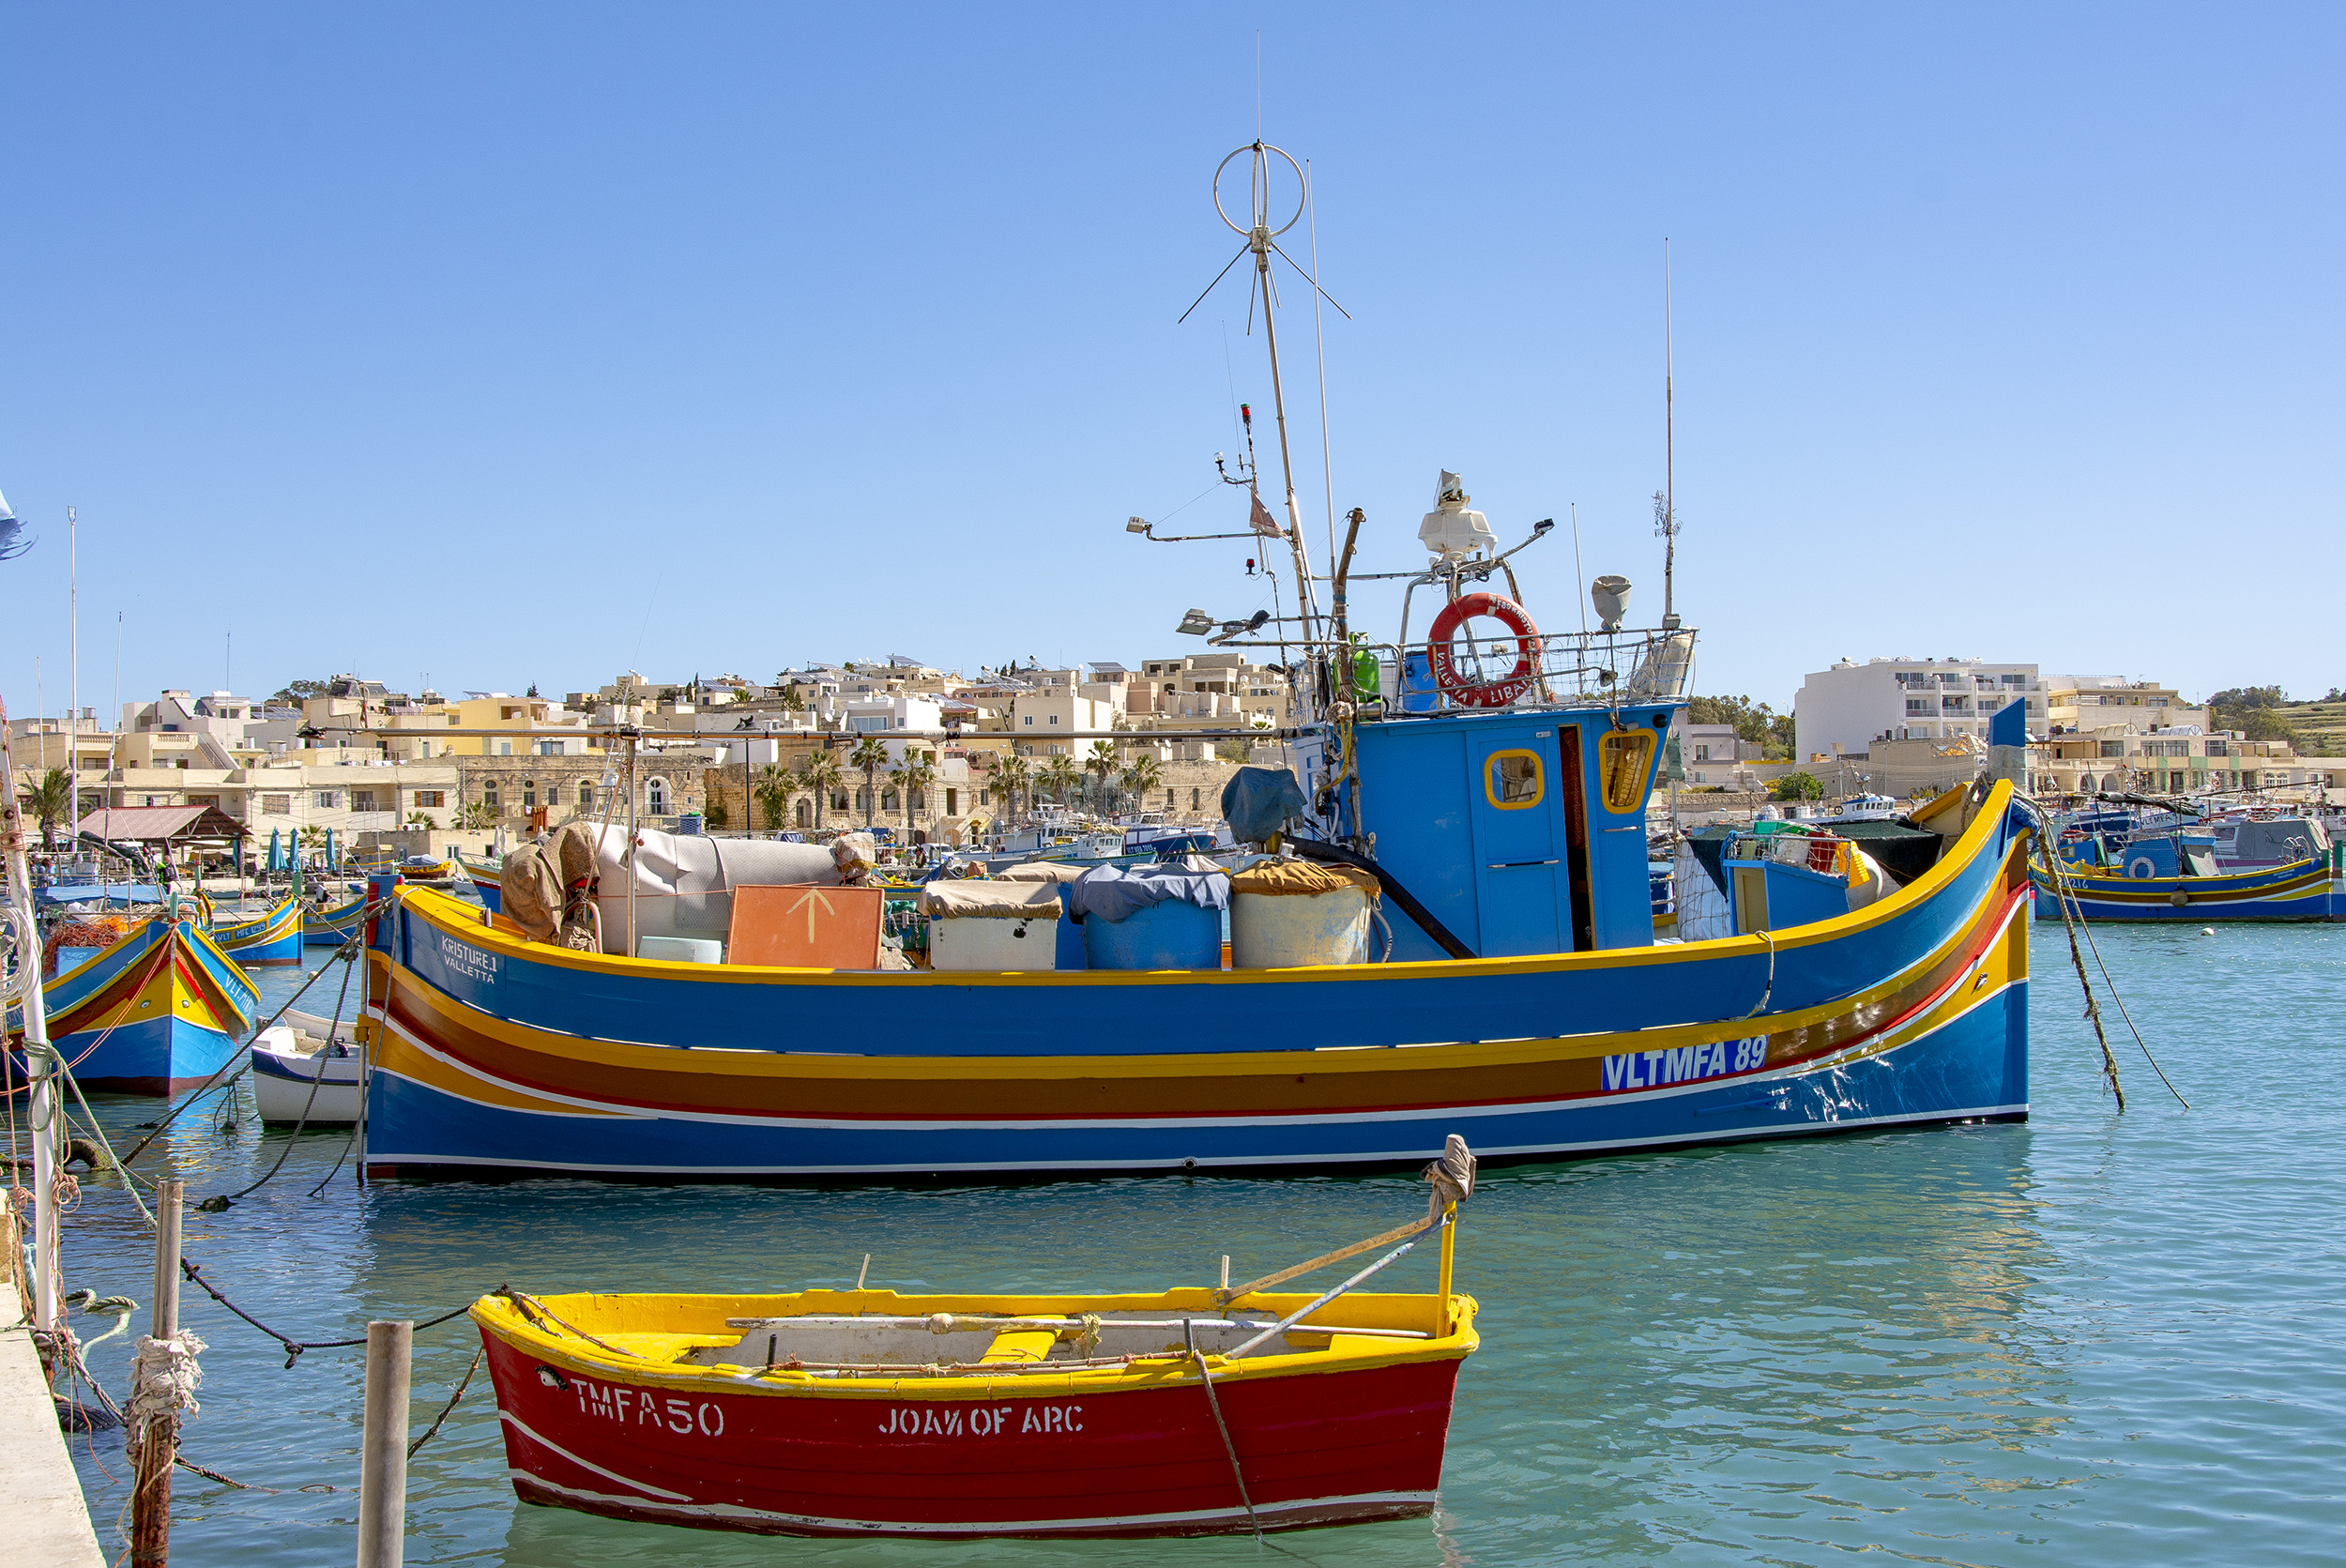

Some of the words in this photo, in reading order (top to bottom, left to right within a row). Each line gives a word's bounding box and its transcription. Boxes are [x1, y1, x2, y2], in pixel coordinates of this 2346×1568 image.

[217, 932, 231, 941] VLT
[251, 922, 267, 934] 1299
[444, 954, 495, 985] VALLETTA
[1734, 1034, 1767, 1072] 89
[970, 1407, 1013, 1437] OF
[1022, 1406, 1083, 1434] ARC
